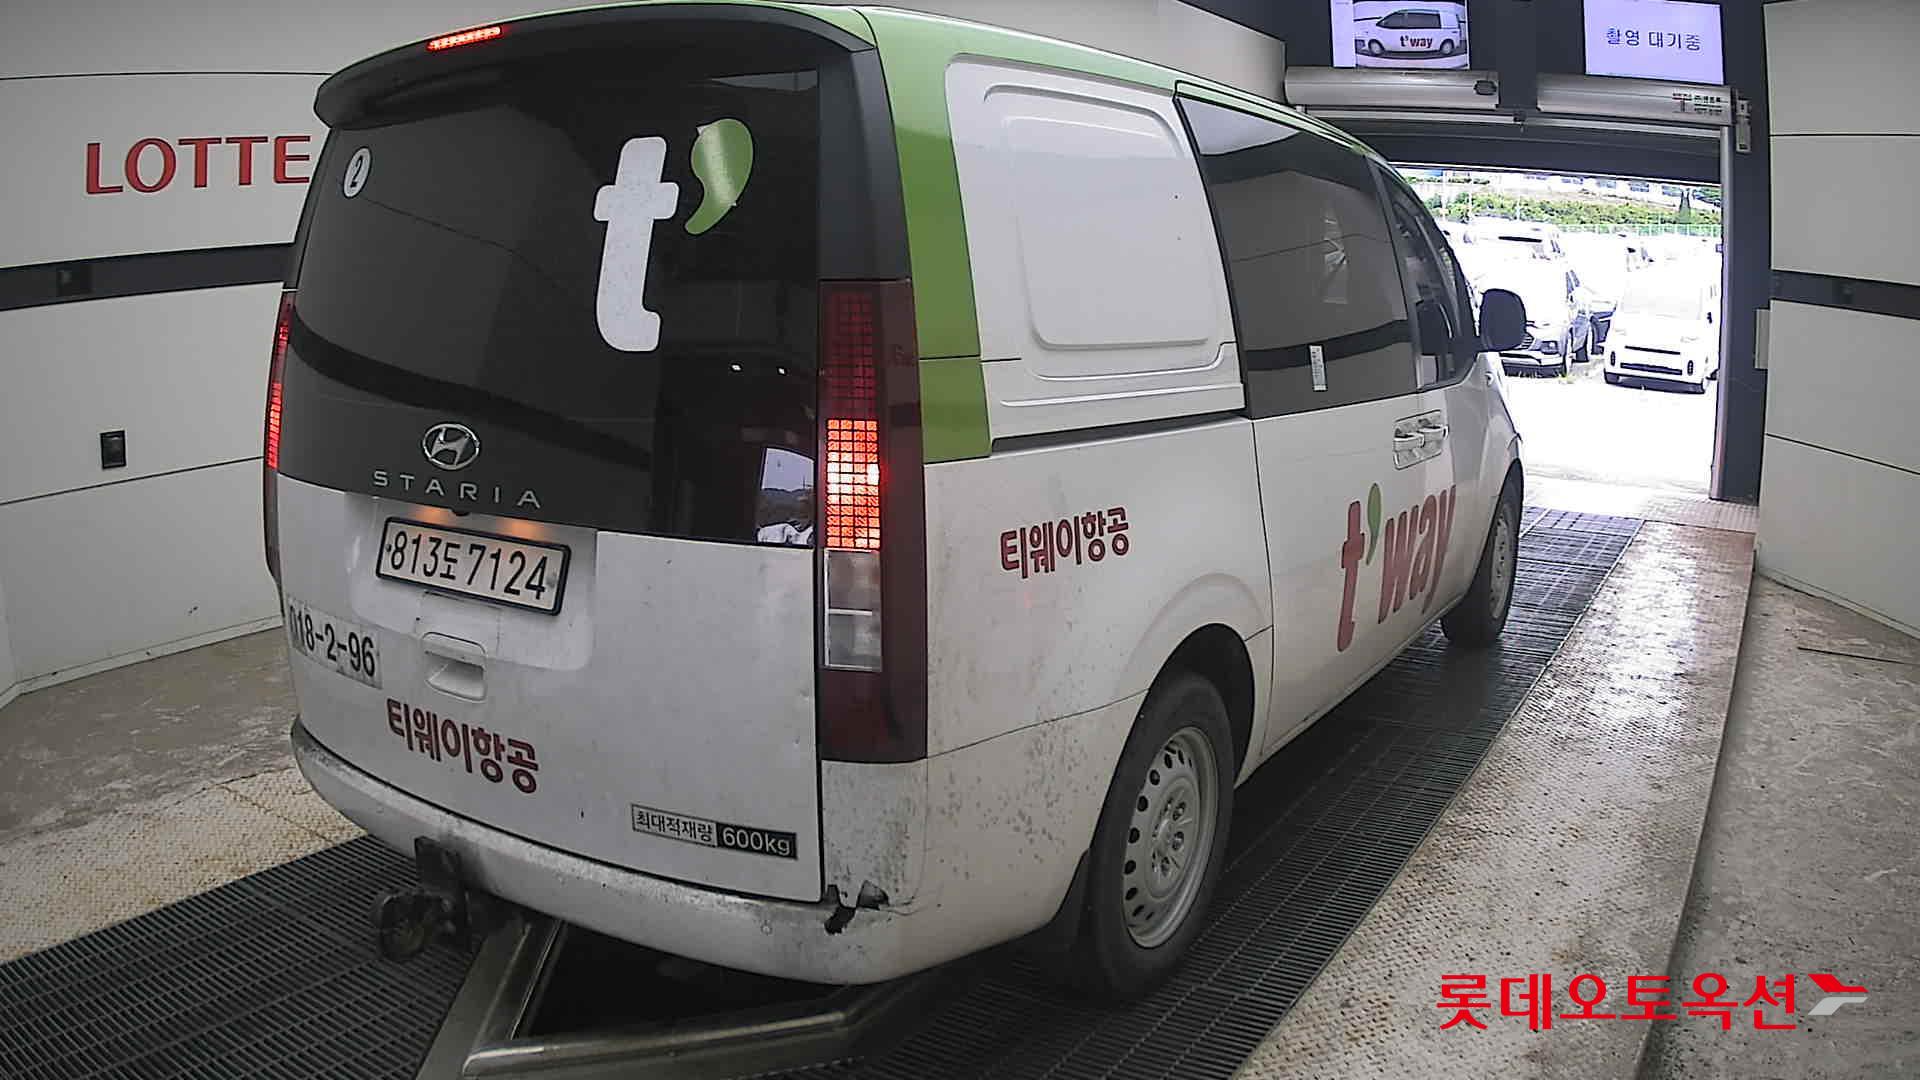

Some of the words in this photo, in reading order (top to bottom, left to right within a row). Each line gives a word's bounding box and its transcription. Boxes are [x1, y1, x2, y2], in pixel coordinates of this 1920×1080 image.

[1649, 31, 1701, 51] 대기중
[86, 135, 311, 195] LOTTE
[373, 470, 541, 509] STARIA
[1000, 507, 1129, 579] 티웨이항공
[386, 698, 539, 794] 티웨이항공
[637, 810, 713, 843] 최대적재량
[722, 826, 791, 856] 600kg
